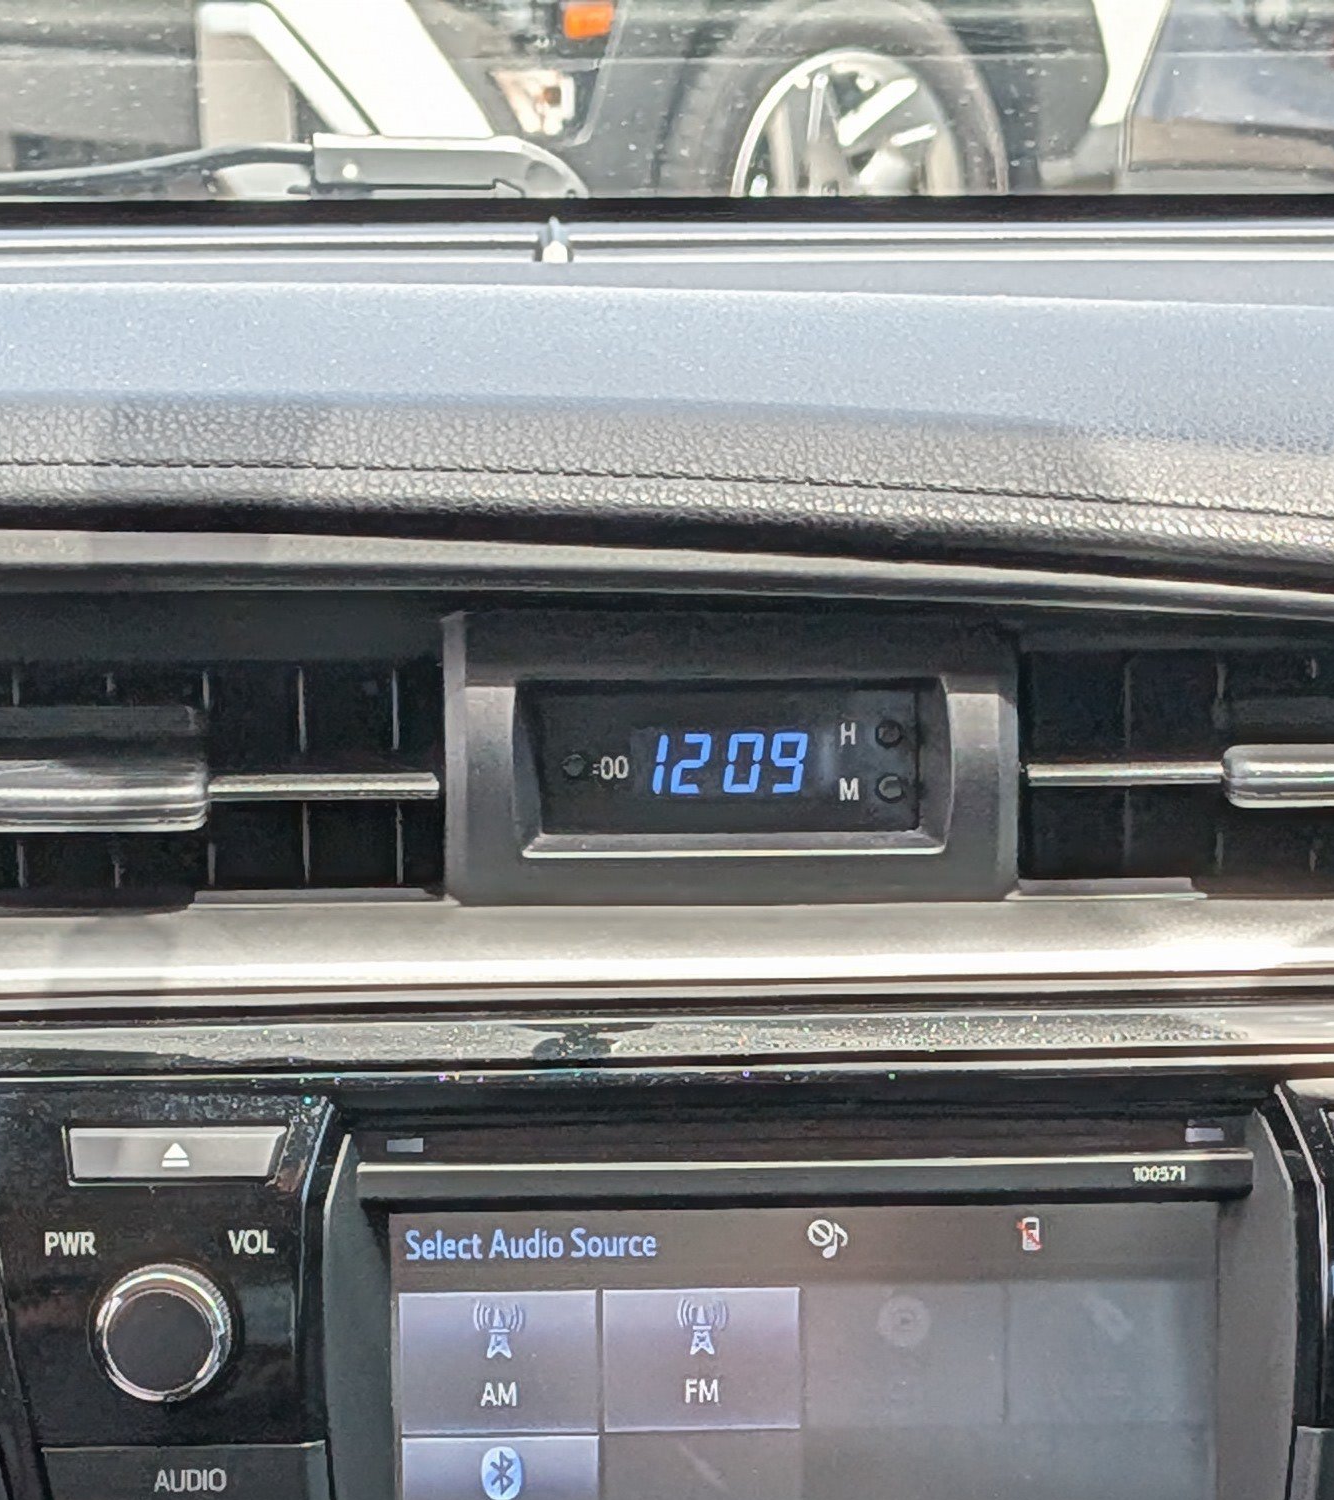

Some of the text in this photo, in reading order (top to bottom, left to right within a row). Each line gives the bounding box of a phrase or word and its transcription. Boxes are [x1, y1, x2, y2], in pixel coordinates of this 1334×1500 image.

[840, 722, 856, 746] H
[652, 732, 809, 795] 1209
[839, 777, 859, 801] M
[44, 1231, 97, 1257] PWR
[228, 1229, 275, 1255] VOL
[404, 1227, 658, 1260] Select Audio Source
[479, 1381, 518, 1408] AM
[684, 1379, 720, 1405] FM
[153, 1468, 227, 1493] AUDIO
